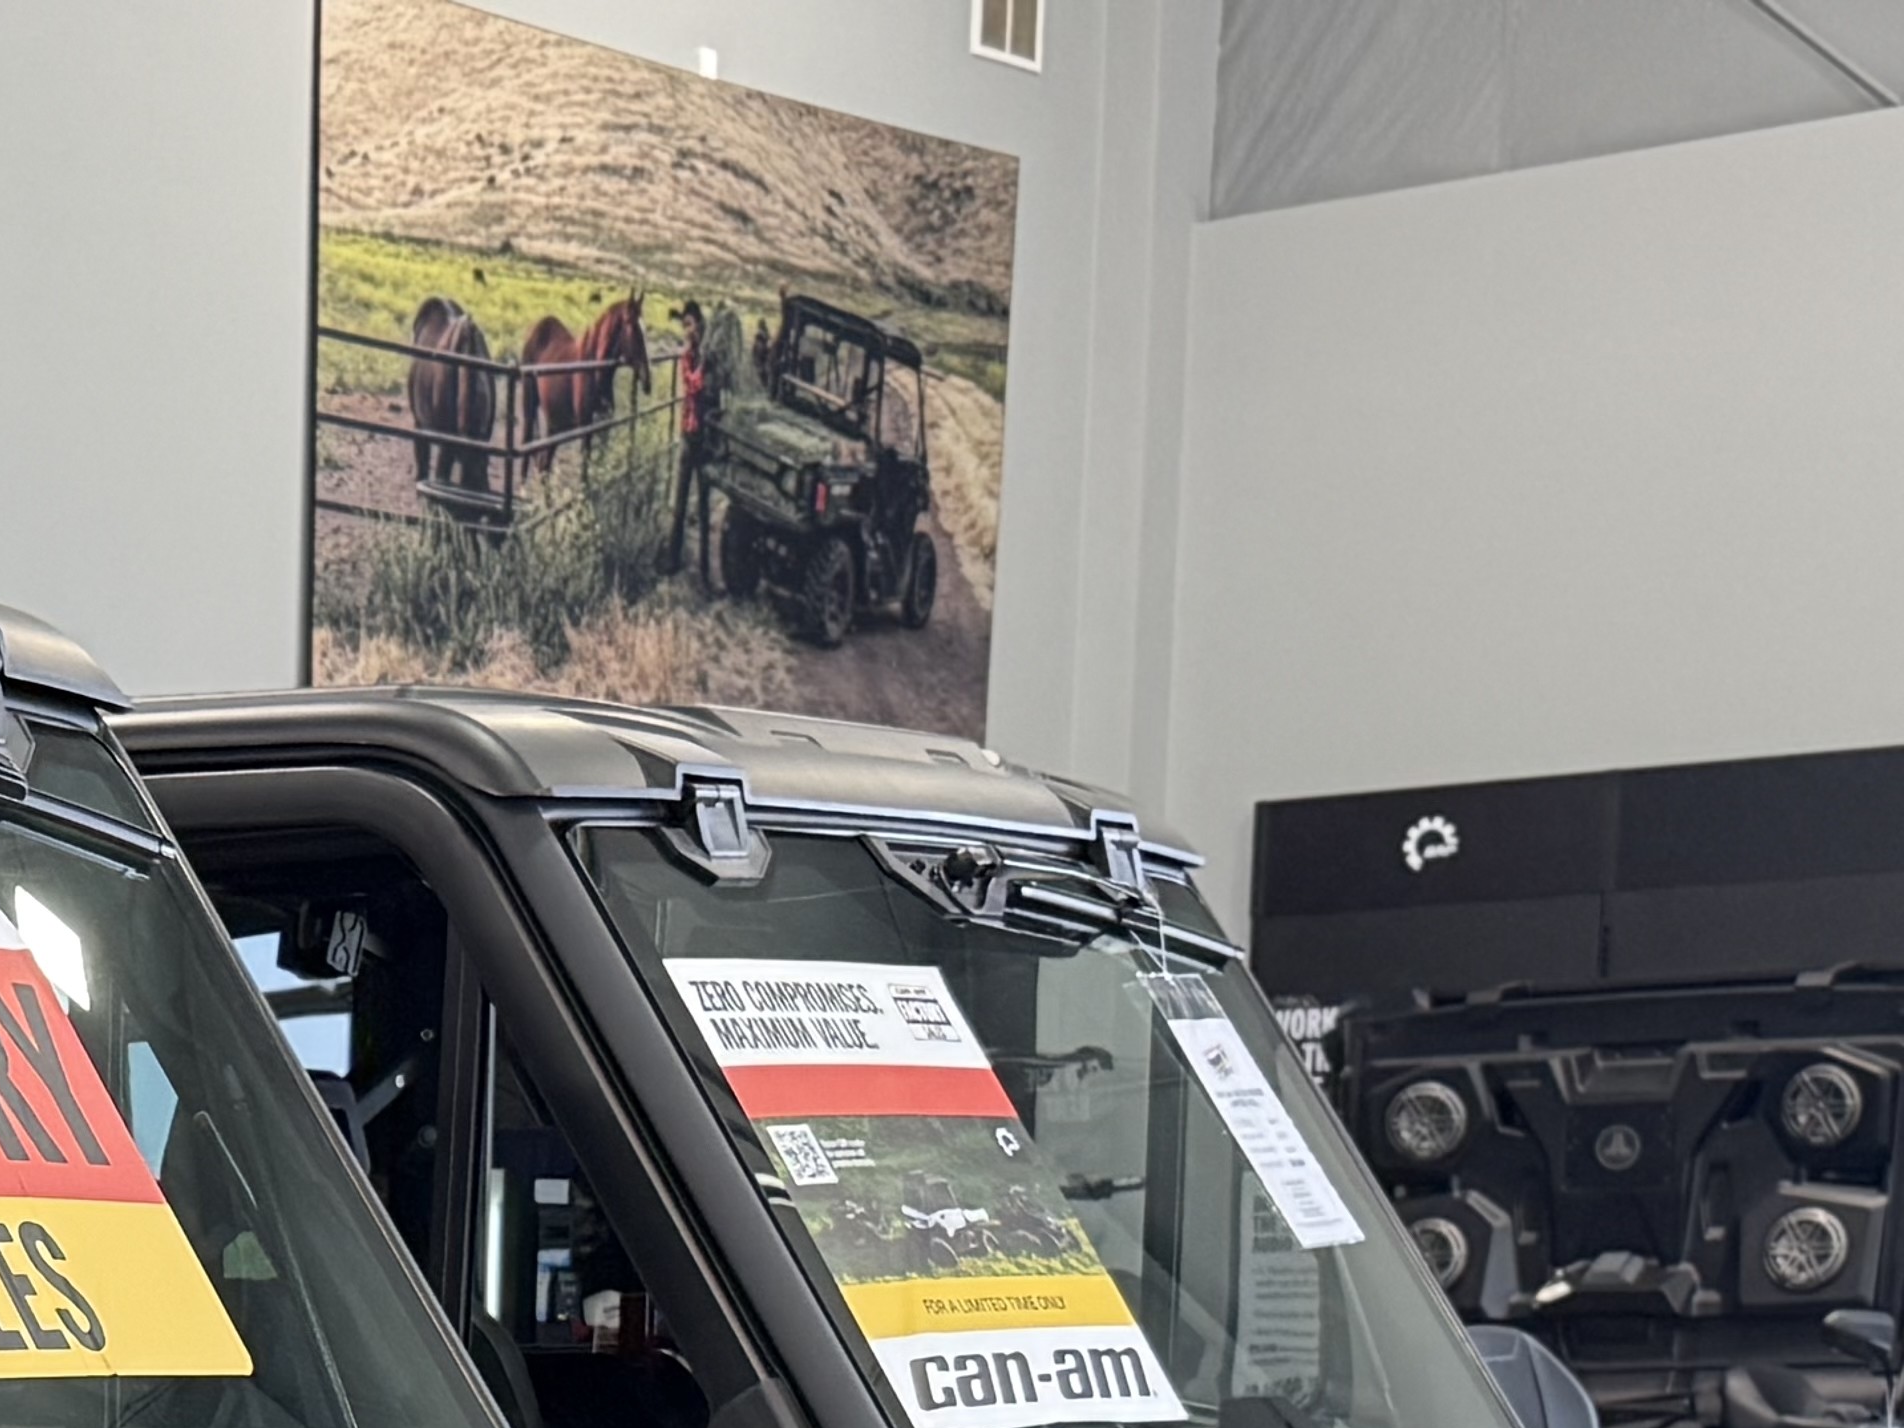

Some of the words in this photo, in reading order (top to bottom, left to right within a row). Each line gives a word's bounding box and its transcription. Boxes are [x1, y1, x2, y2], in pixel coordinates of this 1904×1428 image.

[688, 980, 746, 1012] ZERO
[742, 980, 884, 1015] COMPROMISES.
[709, 1017, 819, 1051] MAXIMUM
[807, 1017, 880, 1050] VALUE.
[923, 1298, 949, 1315] FOR
[959, 1297, 1008, 1314] LIMITED
[1006, 1296, 1039, 1311] TIME
[910, 1345, 1154, 1412] can-am
